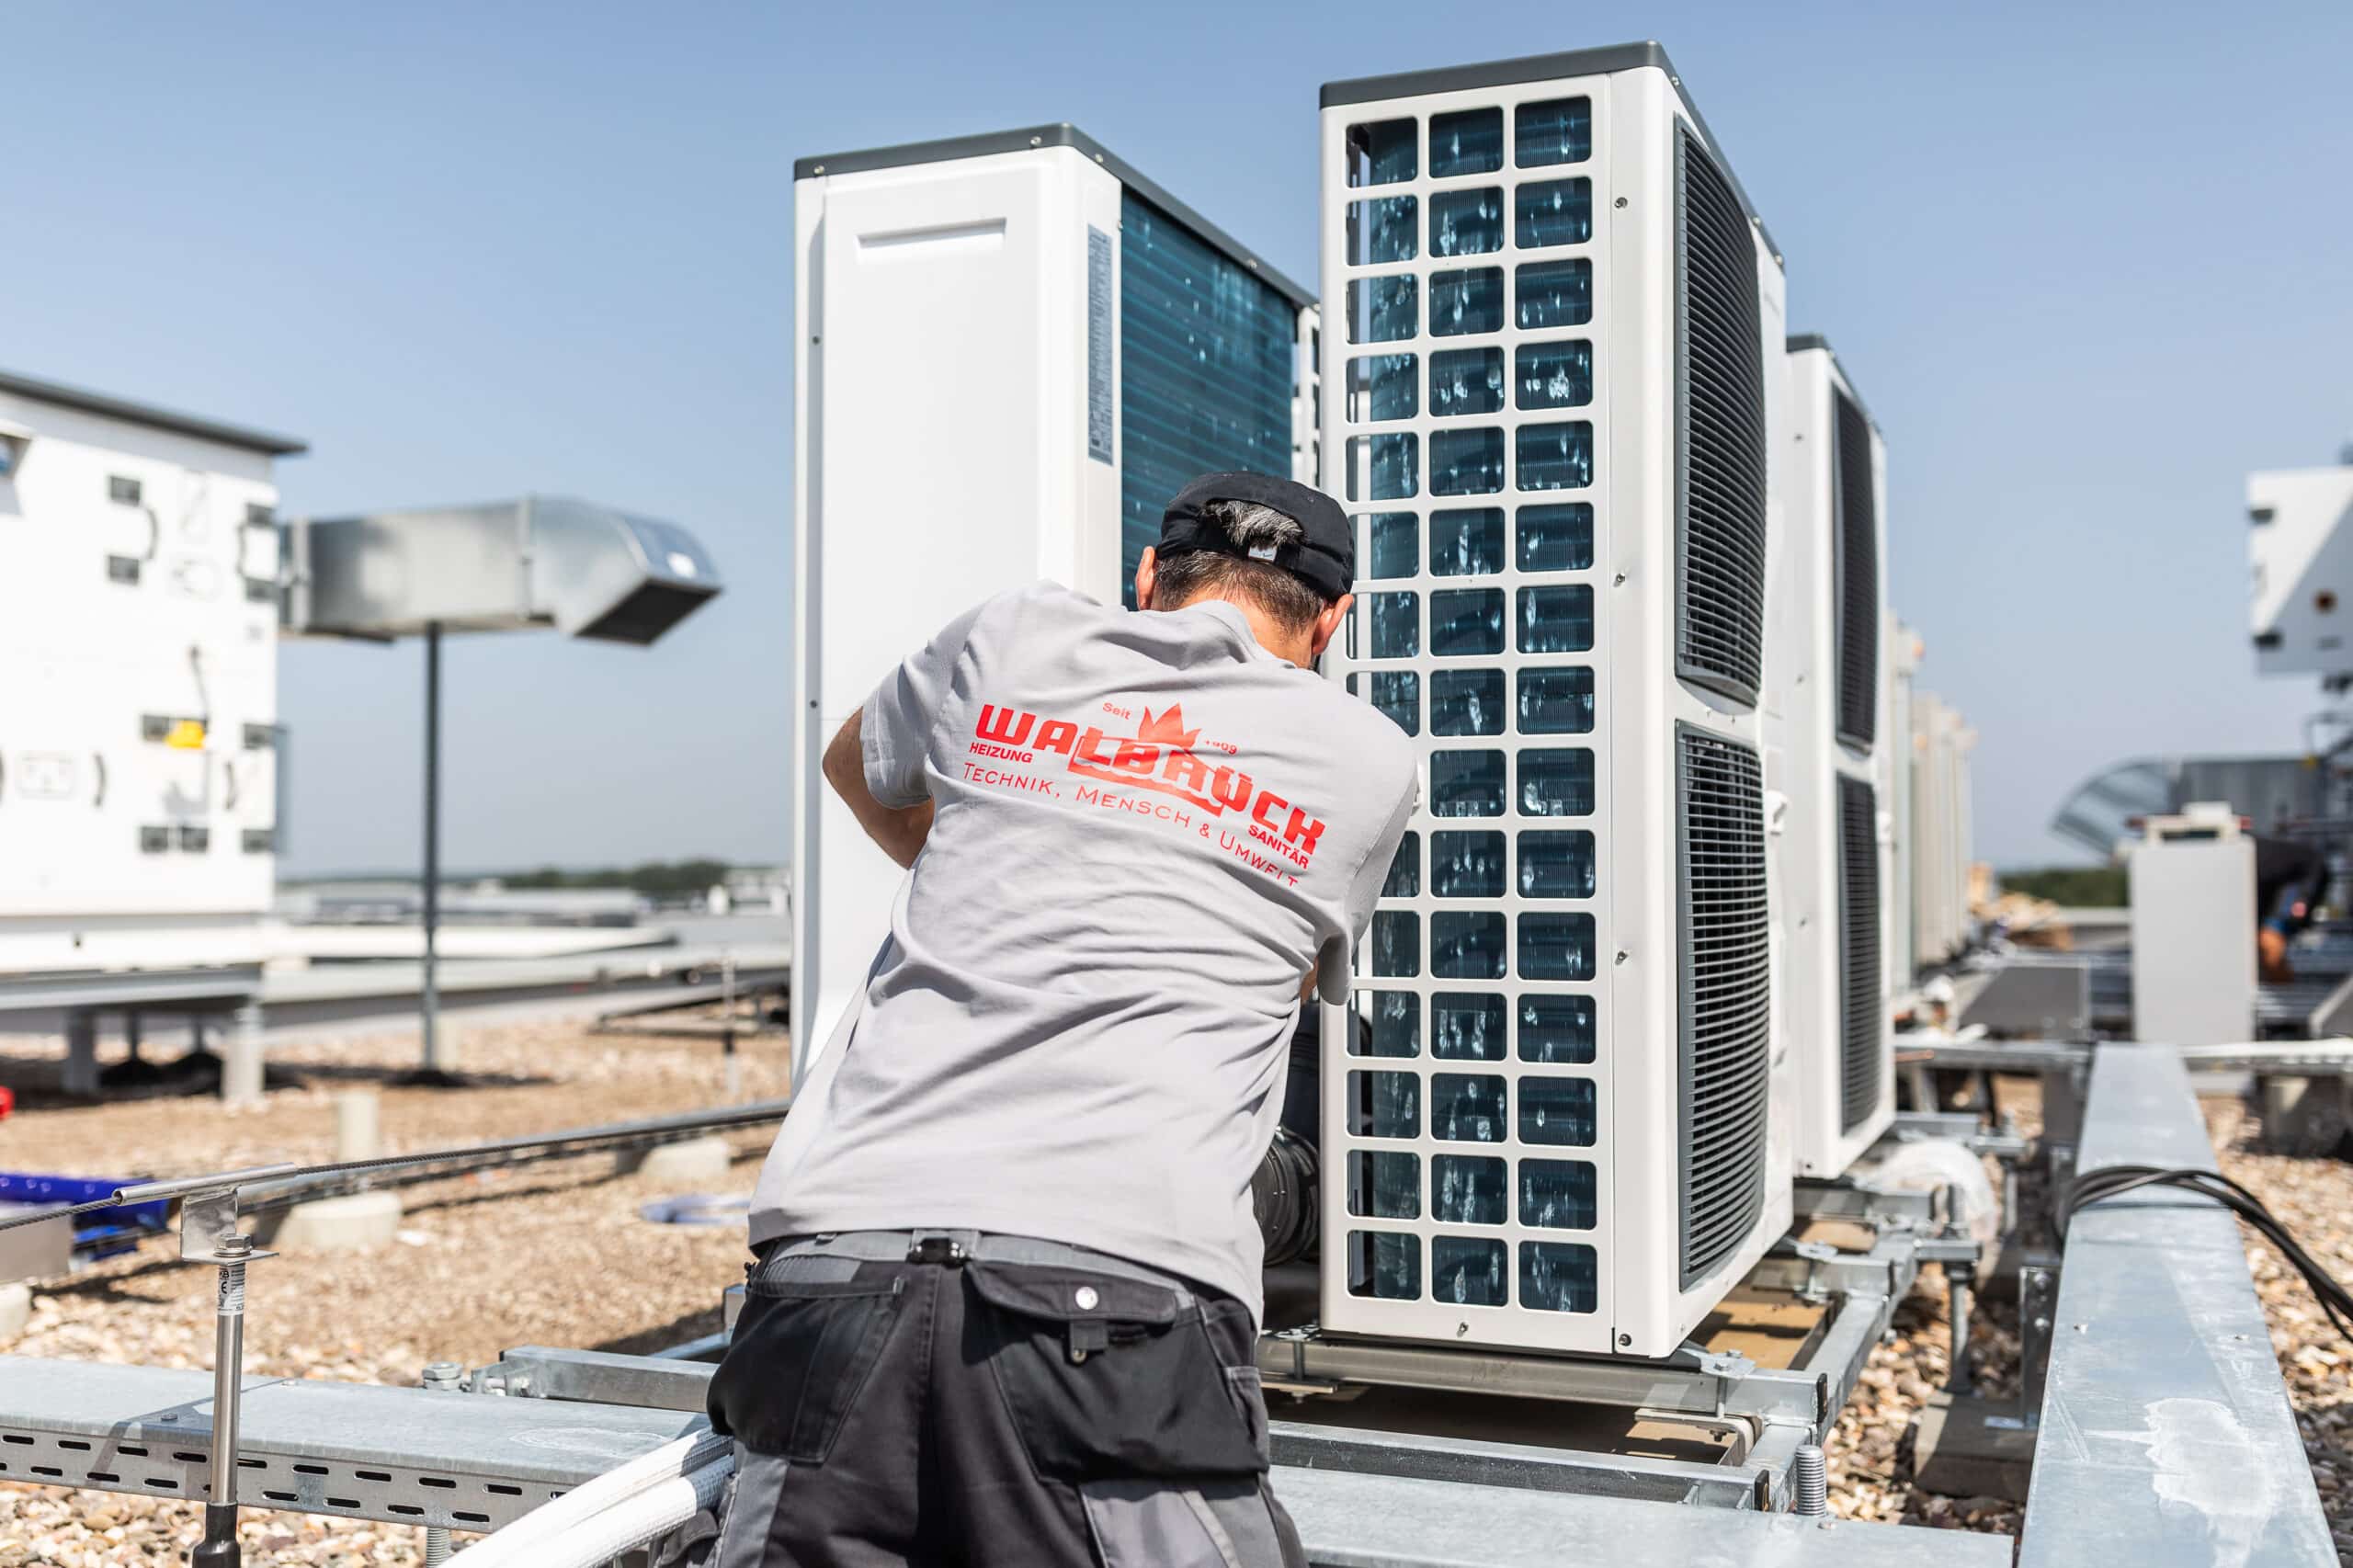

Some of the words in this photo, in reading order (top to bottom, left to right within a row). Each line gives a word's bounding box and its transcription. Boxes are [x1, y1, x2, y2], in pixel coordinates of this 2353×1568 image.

[1103, 701, 1131, 721] Seit
[969, 742, 1033, 764] HEIZUNG
[1075, 785, 1190, 828] MENSCH
[1199, 823, 1210, 838] &
[1248, 824, 1309, 869] SANITÄR
